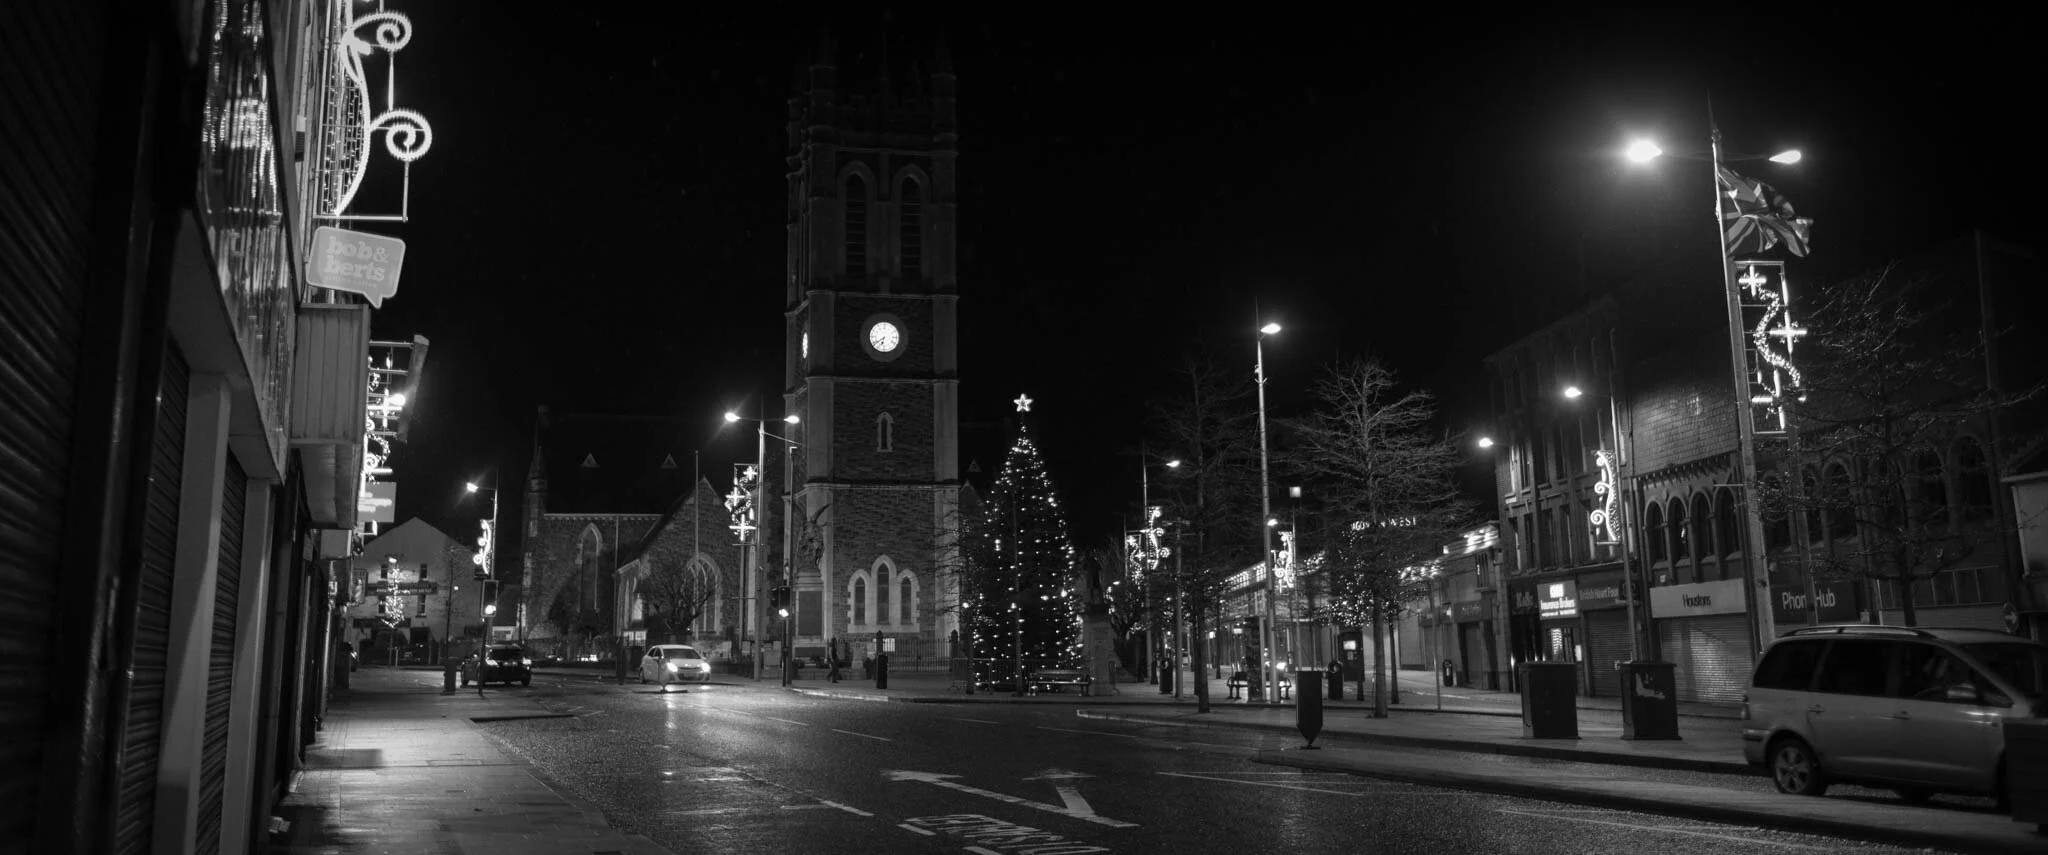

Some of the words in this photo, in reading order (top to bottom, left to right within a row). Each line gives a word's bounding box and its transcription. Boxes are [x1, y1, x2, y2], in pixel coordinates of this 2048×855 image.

[324, 254, 386, 283] berts
[1682, 593, 1711, 608] Houstons
[1782, 590, 1809, 610] Phon
[1815, 587, 1836, 608] Hub
